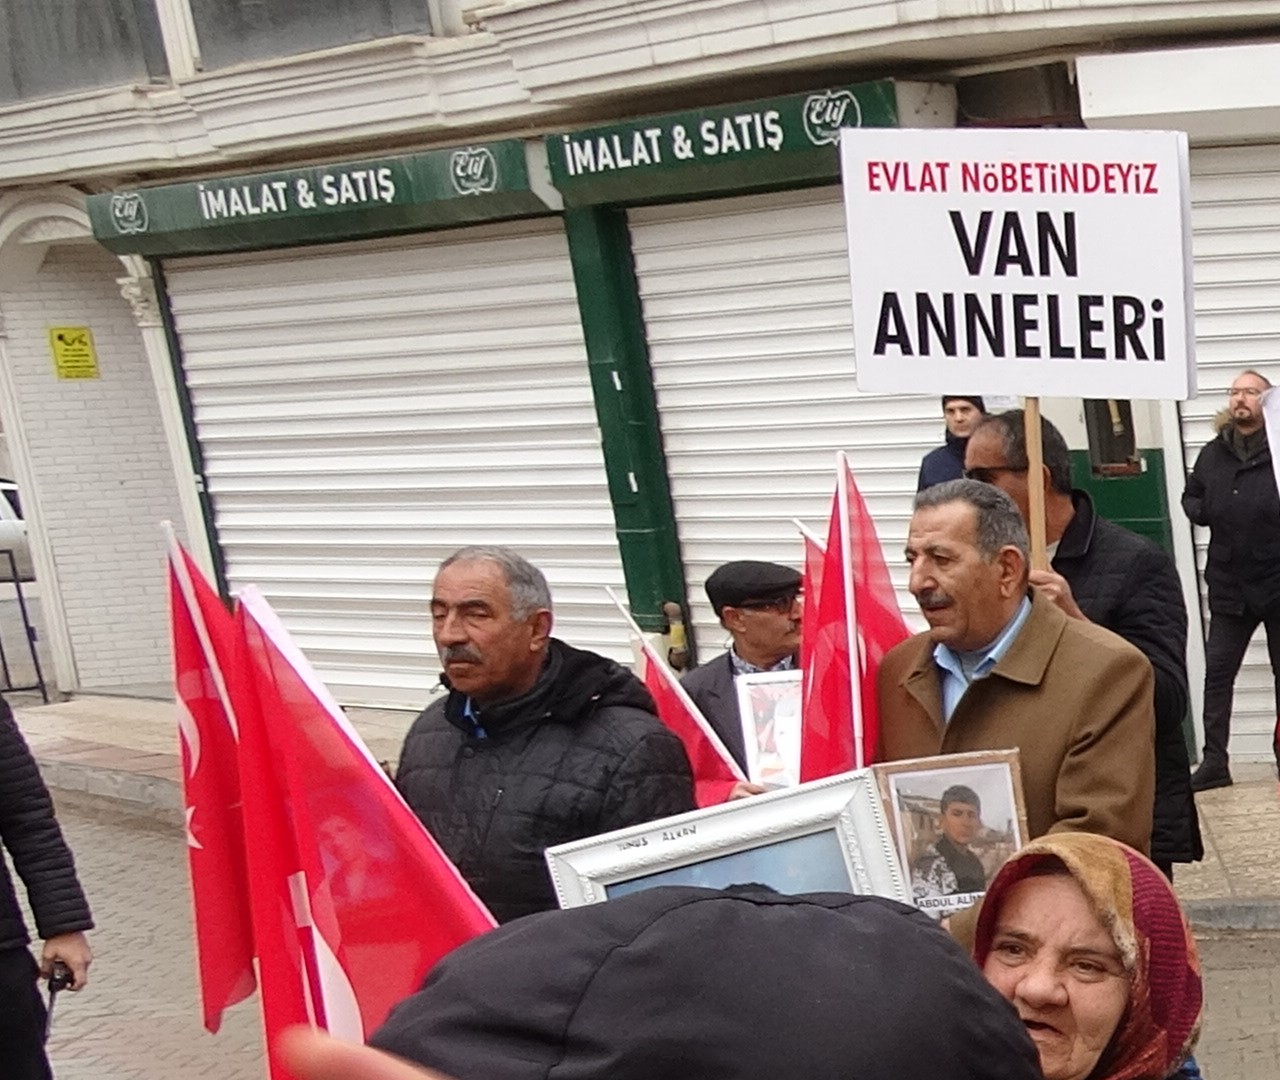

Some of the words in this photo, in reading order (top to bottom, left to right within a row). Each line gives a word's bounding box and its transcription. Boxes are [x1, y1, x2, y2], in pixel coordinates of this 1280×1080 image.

[564, 127, 662, 176] İMALAT
[672, 125, 695, 160] &
[701, 110, 784, 151] SATIŞ
[200, 181, 288, 220] İMALAT
[298, 179, 316, 209] &
[322, 168, 396, 204] SATIŞ
[867, 161, 950, 191] EVLAT
[948, 210, 1078, 277] VAN
[919, 898, 954, 908] ABDUL
